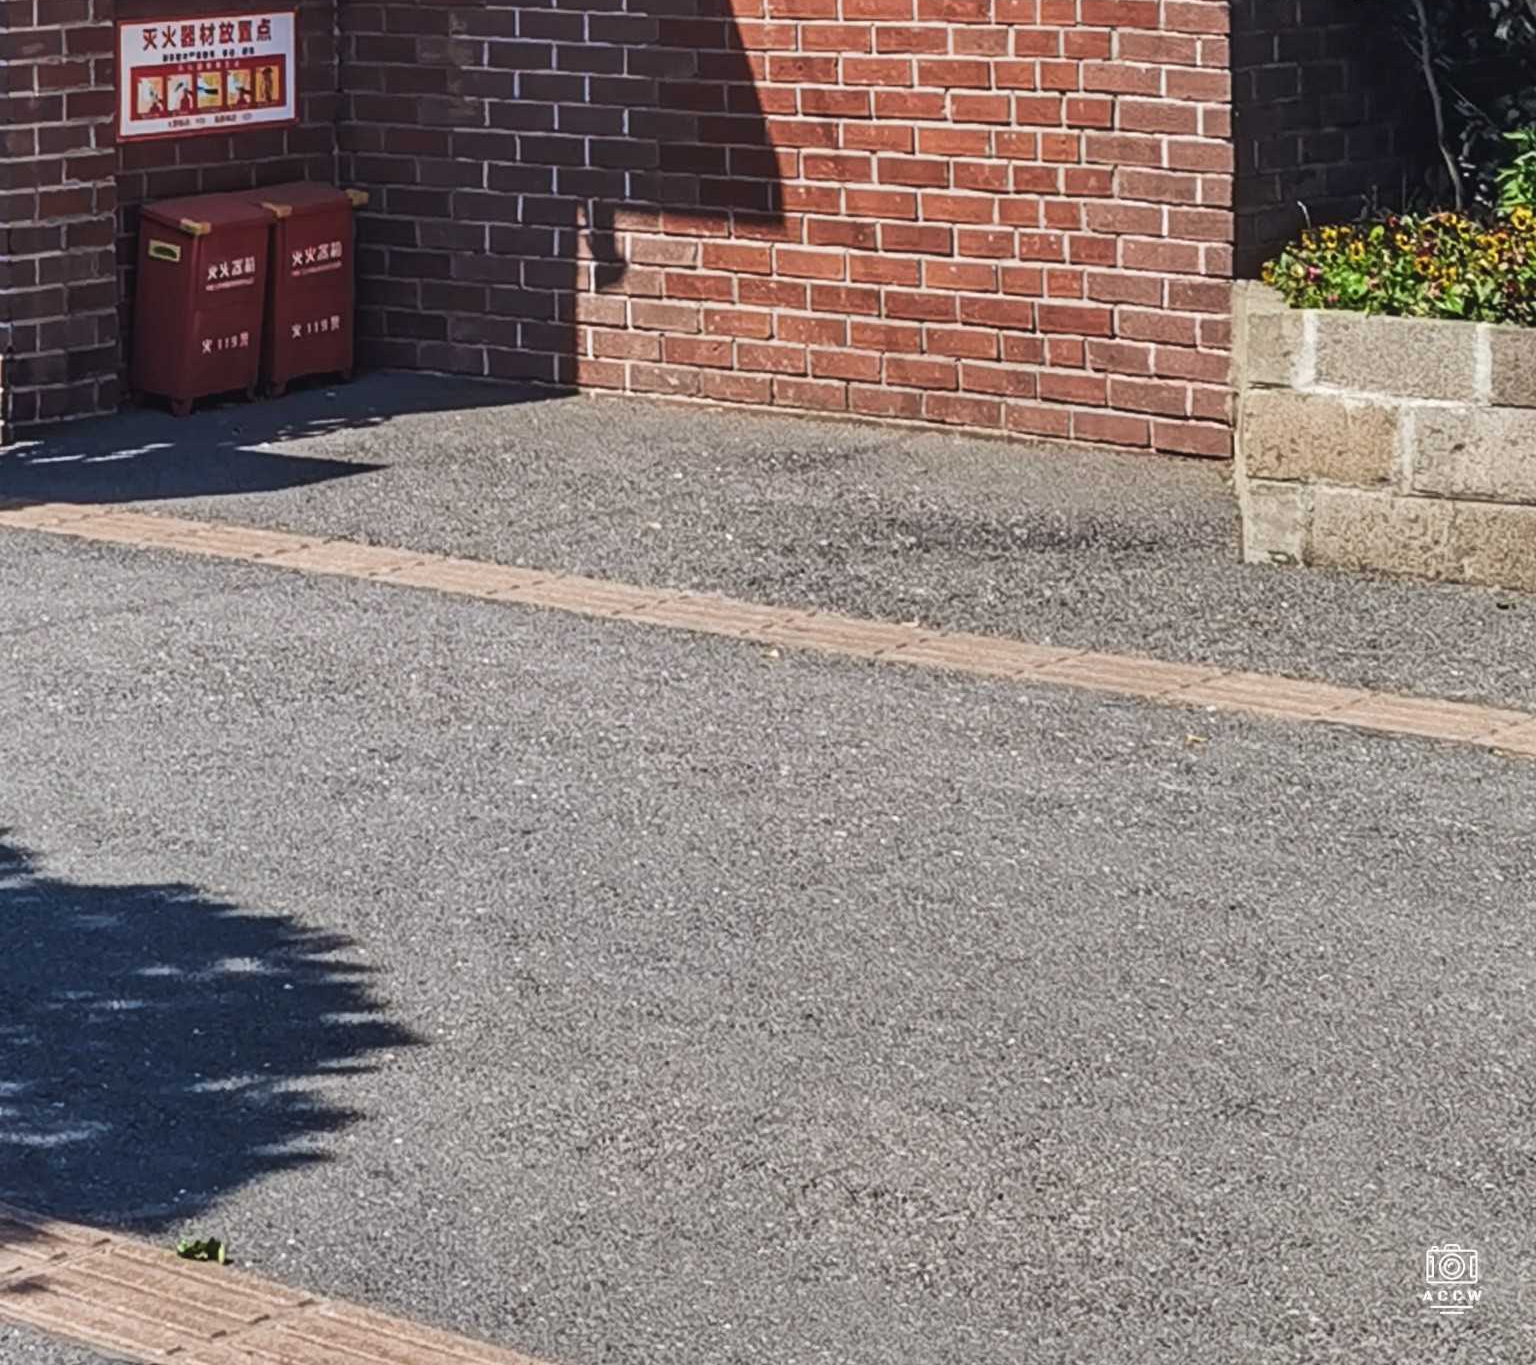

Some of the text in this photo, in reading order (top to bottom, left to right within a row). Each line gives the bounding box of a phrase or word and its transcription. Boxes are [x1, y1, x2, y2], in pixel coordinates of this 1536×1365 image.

[142, 19, 272, 51] 灭火器材放置点
